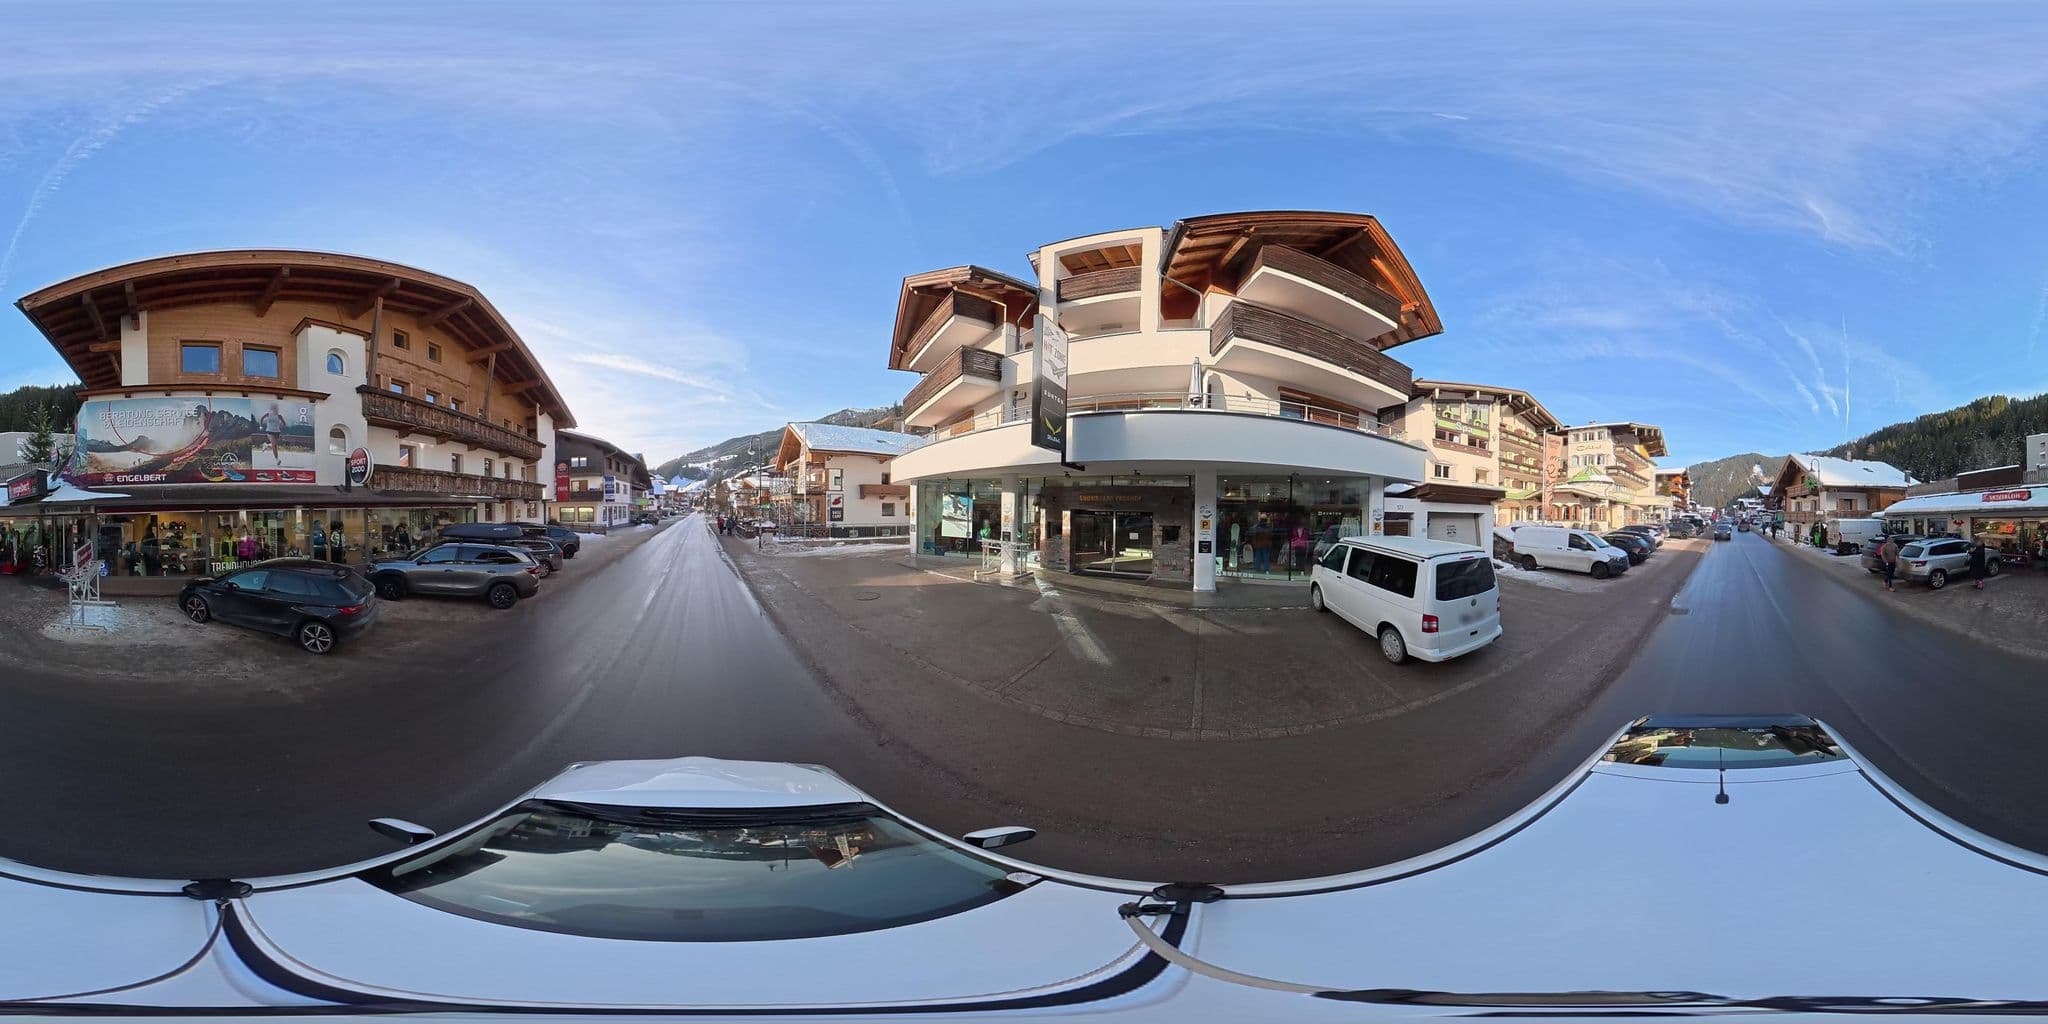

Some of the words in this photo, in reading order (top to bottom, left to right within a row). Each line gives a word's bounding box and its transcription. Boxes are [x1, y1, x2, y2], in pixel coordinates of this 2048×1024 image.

[1044, 389, 1064, 405] BURTON
[157, 408, 199, 418] SERVICE
[1456, 421, 1473, 434] Spa
[351, 457, 366, 466] SPORT
[352, 465, 365, 474] 2000
[116, 474, 167, 482] ENGELBERT
[1202, 521, 1209, 529] P
